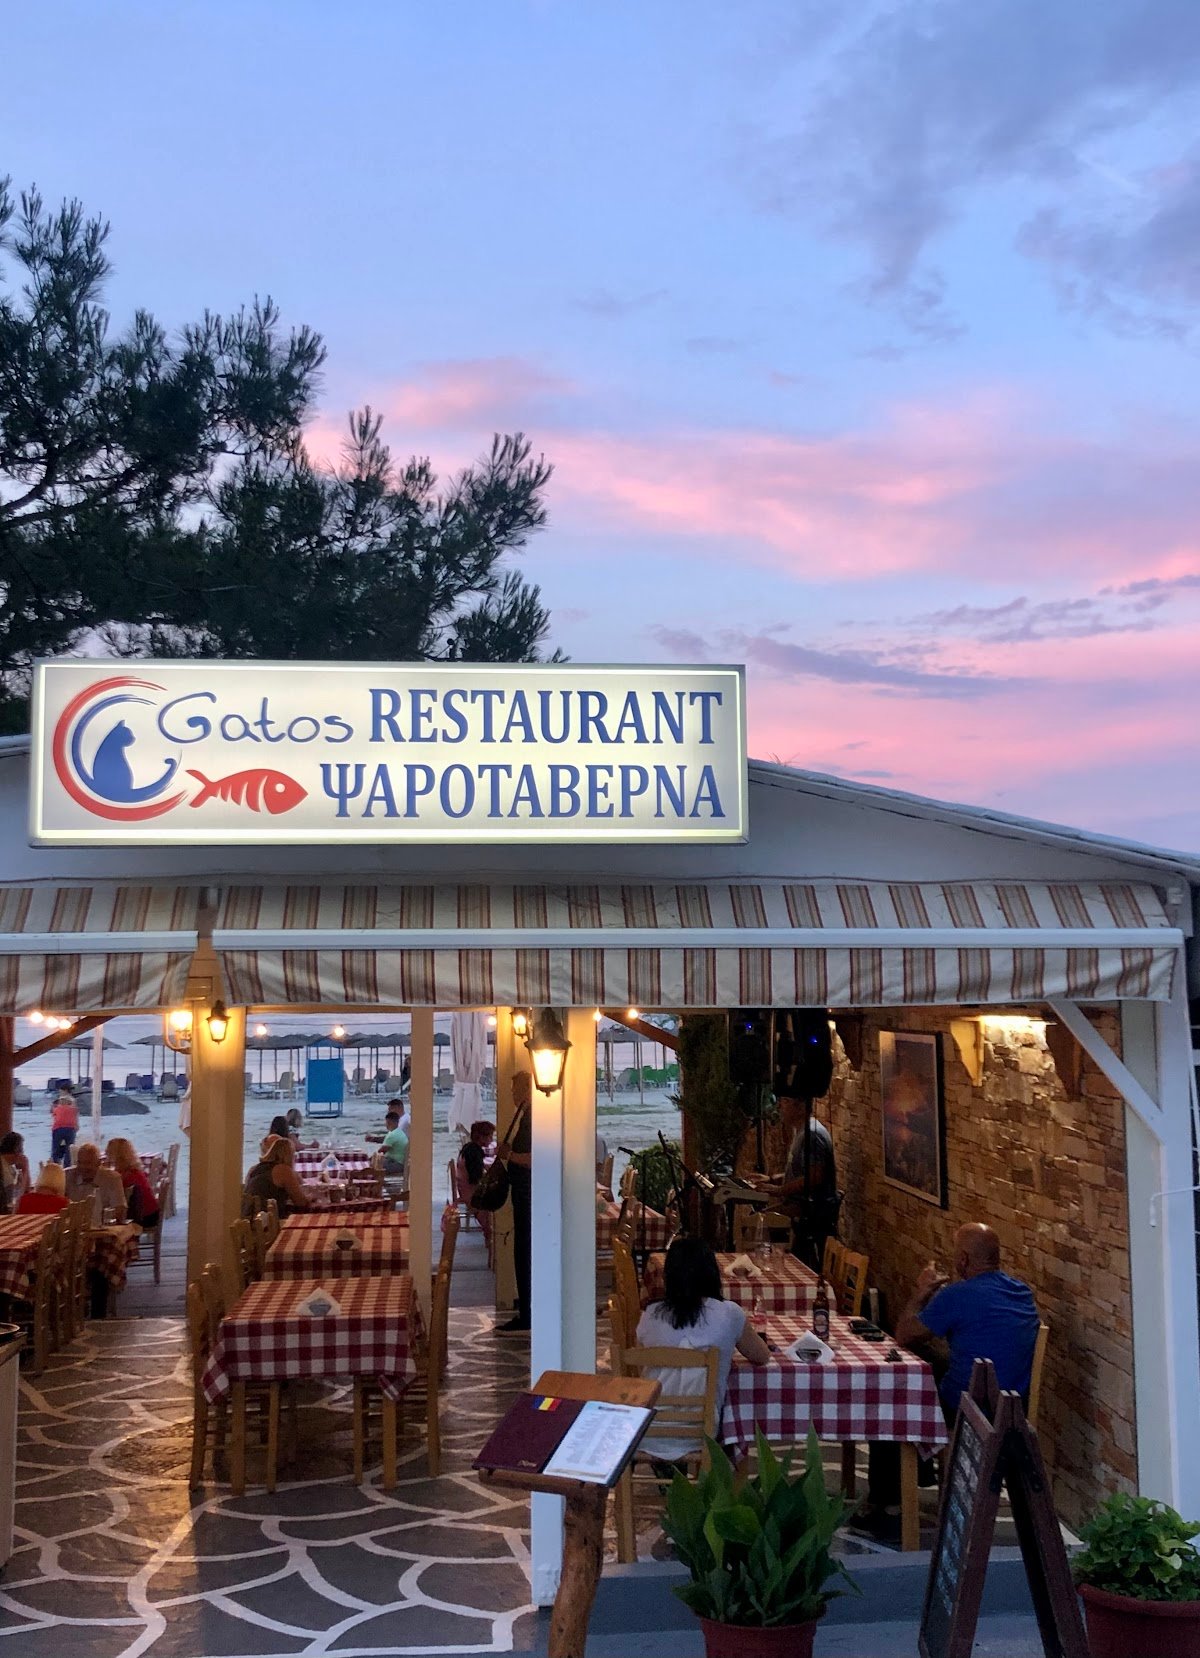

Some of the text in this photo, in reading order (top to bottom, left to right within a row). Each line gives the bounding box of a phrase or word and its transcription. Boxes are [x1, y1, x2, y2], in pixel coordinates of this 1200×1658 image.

[157, 688, 724, 745] Gatos RESTAURANT
[320, 763, 726, 820] ΨΑΡΟΤΑΒΕΡΝΑ
